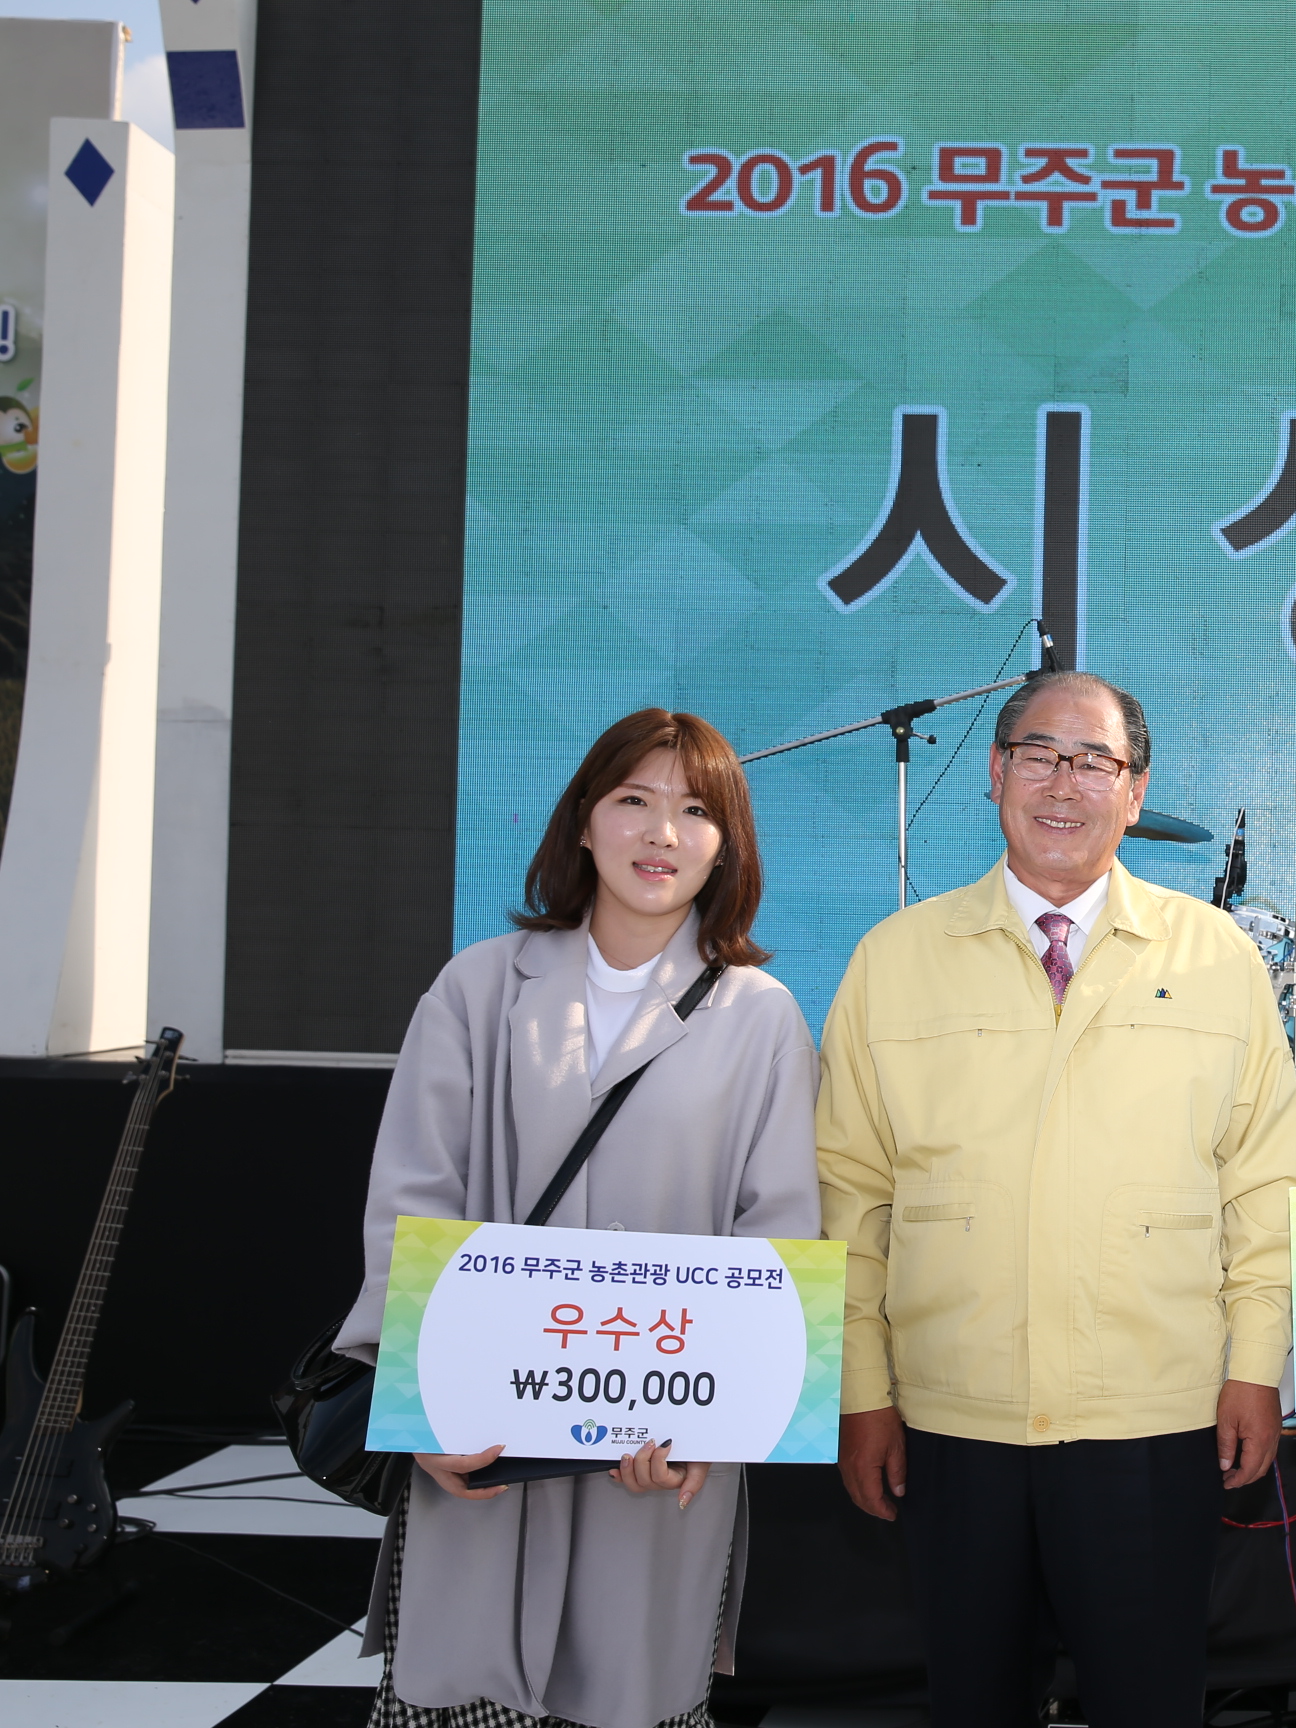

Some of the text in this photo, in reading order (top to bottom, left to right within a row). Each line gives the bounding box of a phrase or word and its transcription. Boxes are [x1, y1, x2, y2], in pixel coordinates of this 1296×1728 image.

[684, 139, 903, 214] 2016
[927, 144, 1185, 228] 무주군
[457, 1252, 784, 1290] 2016 무주군 농촌관광 UCC 공모전
[542, 1303, 694, 1355] 우수상
[509, 1366, 716, 1411] ₩300,000
[611, 1426, 649, 1439] 무주군
